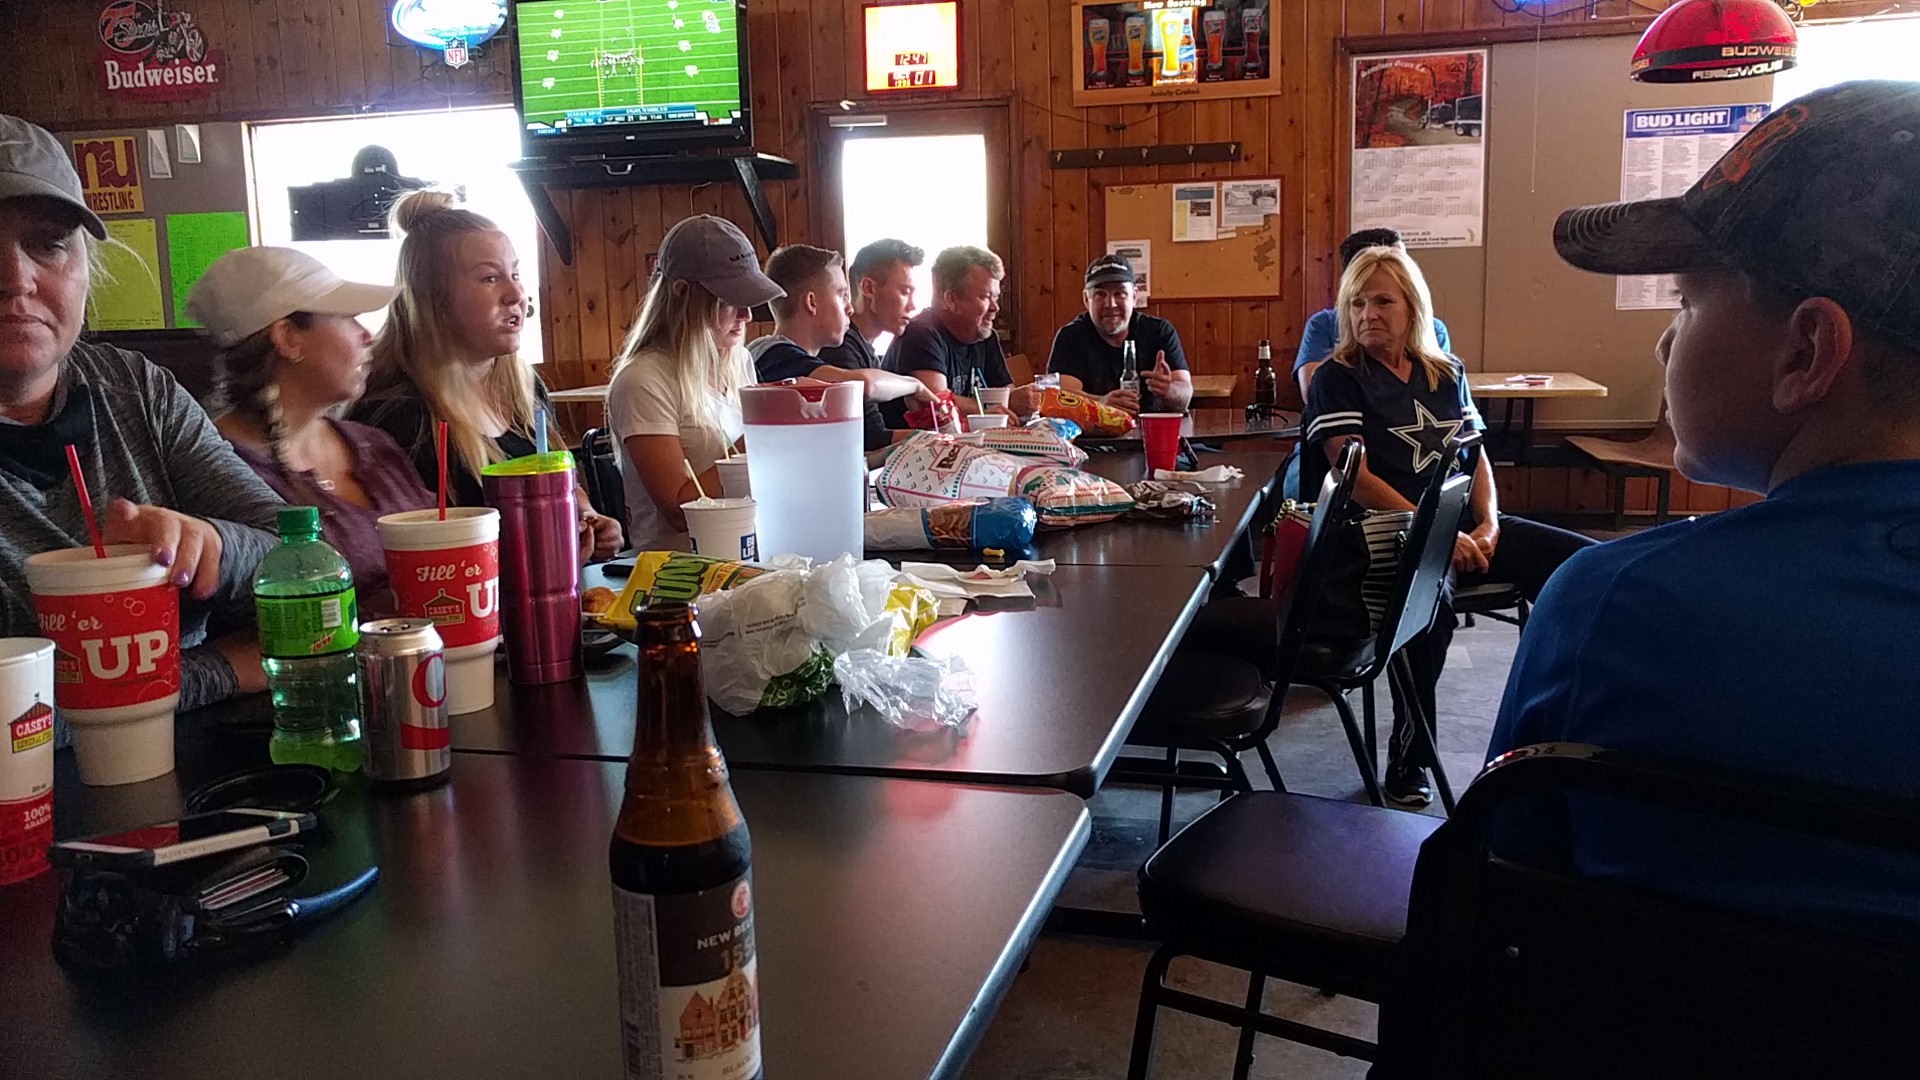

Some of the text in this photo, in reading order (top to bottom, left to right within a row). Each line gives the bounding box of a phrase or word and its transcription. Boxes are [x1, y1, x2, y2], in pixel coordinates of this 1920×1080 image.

[447, 49, 465, 62] NFL
[1722, 45, 1798, 57] BUDWEISE
[105, 58, 216, 90] Budweiser
[1636, 111, 1727, 128] BUD LIGHT
[416, 564, 457, 582] Fill
[428, 604, 461, 616] CASEY'S
[81, 629, 169, 680] UP
[697, 929, 731, 951] NEW
